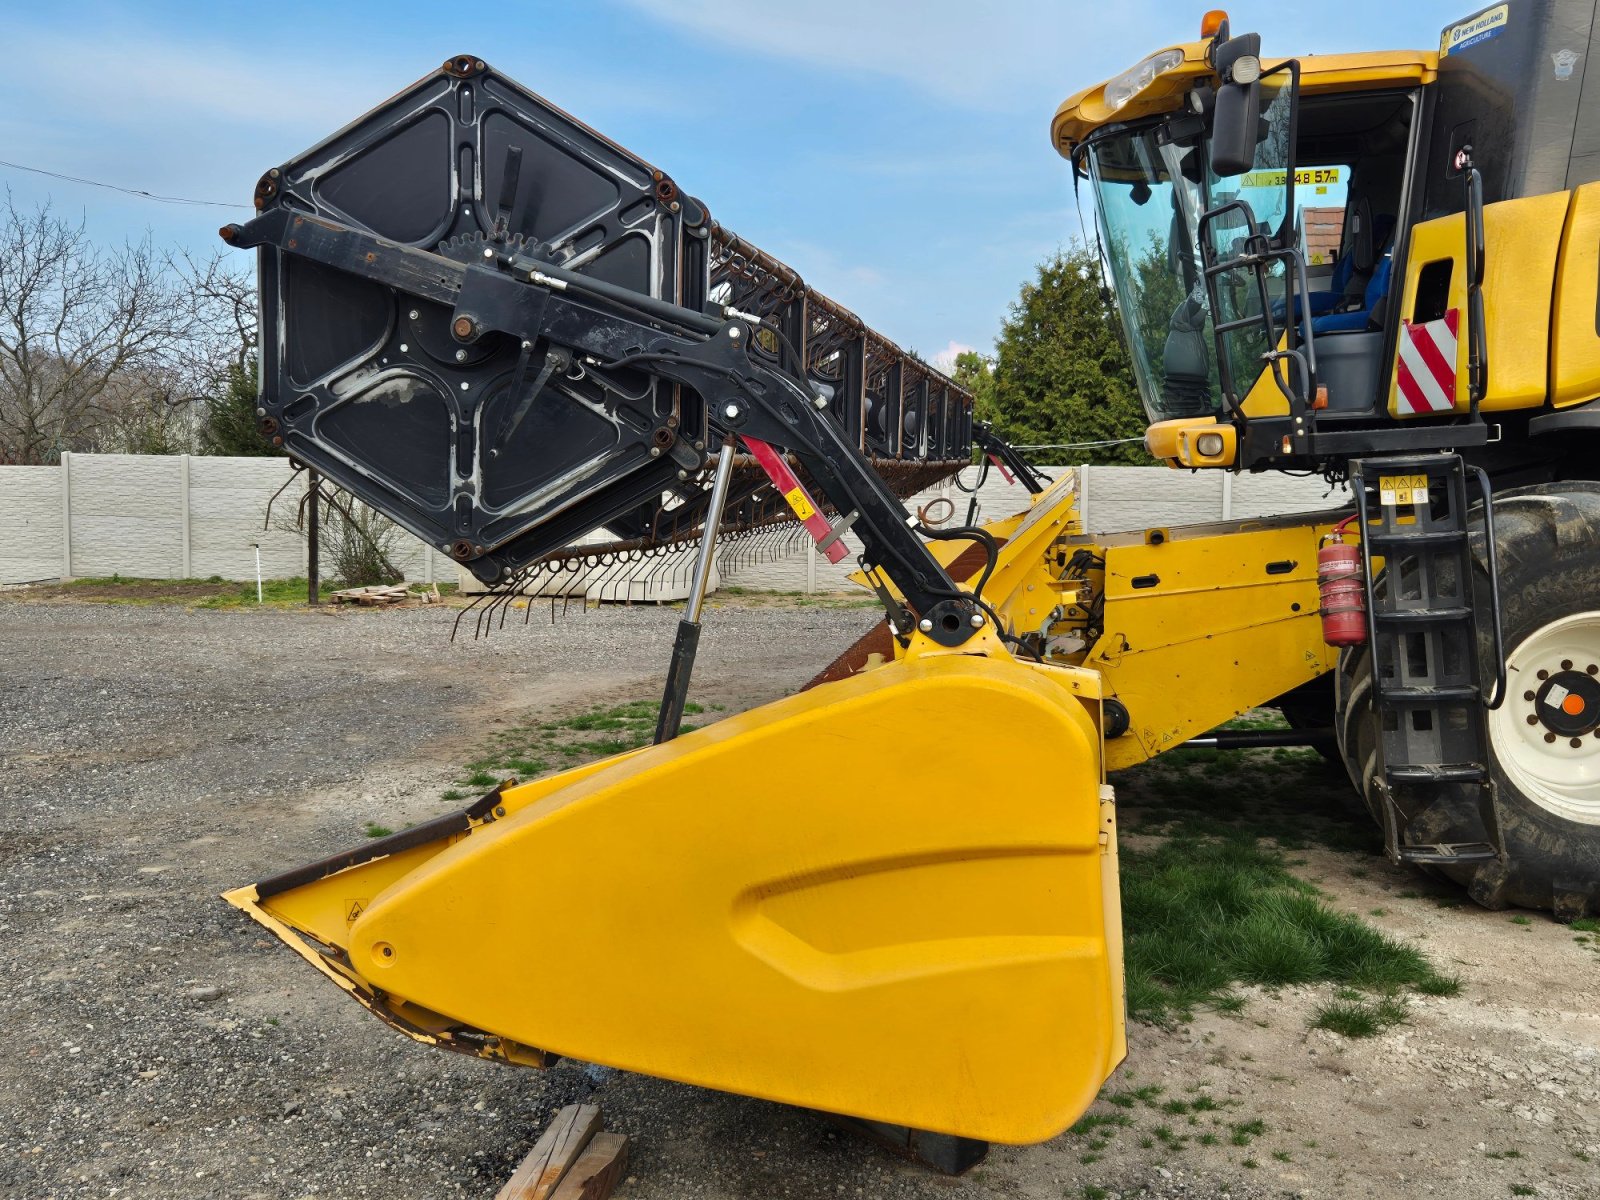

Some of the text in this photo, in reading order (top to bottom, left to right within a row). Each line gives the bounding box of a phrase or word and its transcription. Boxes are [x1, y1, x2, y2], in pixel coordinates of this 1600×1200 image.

[1461, 12, 1504, 36] NEW HOLLAND
[1459, 31, 1492, 49] AGRICULTURE
